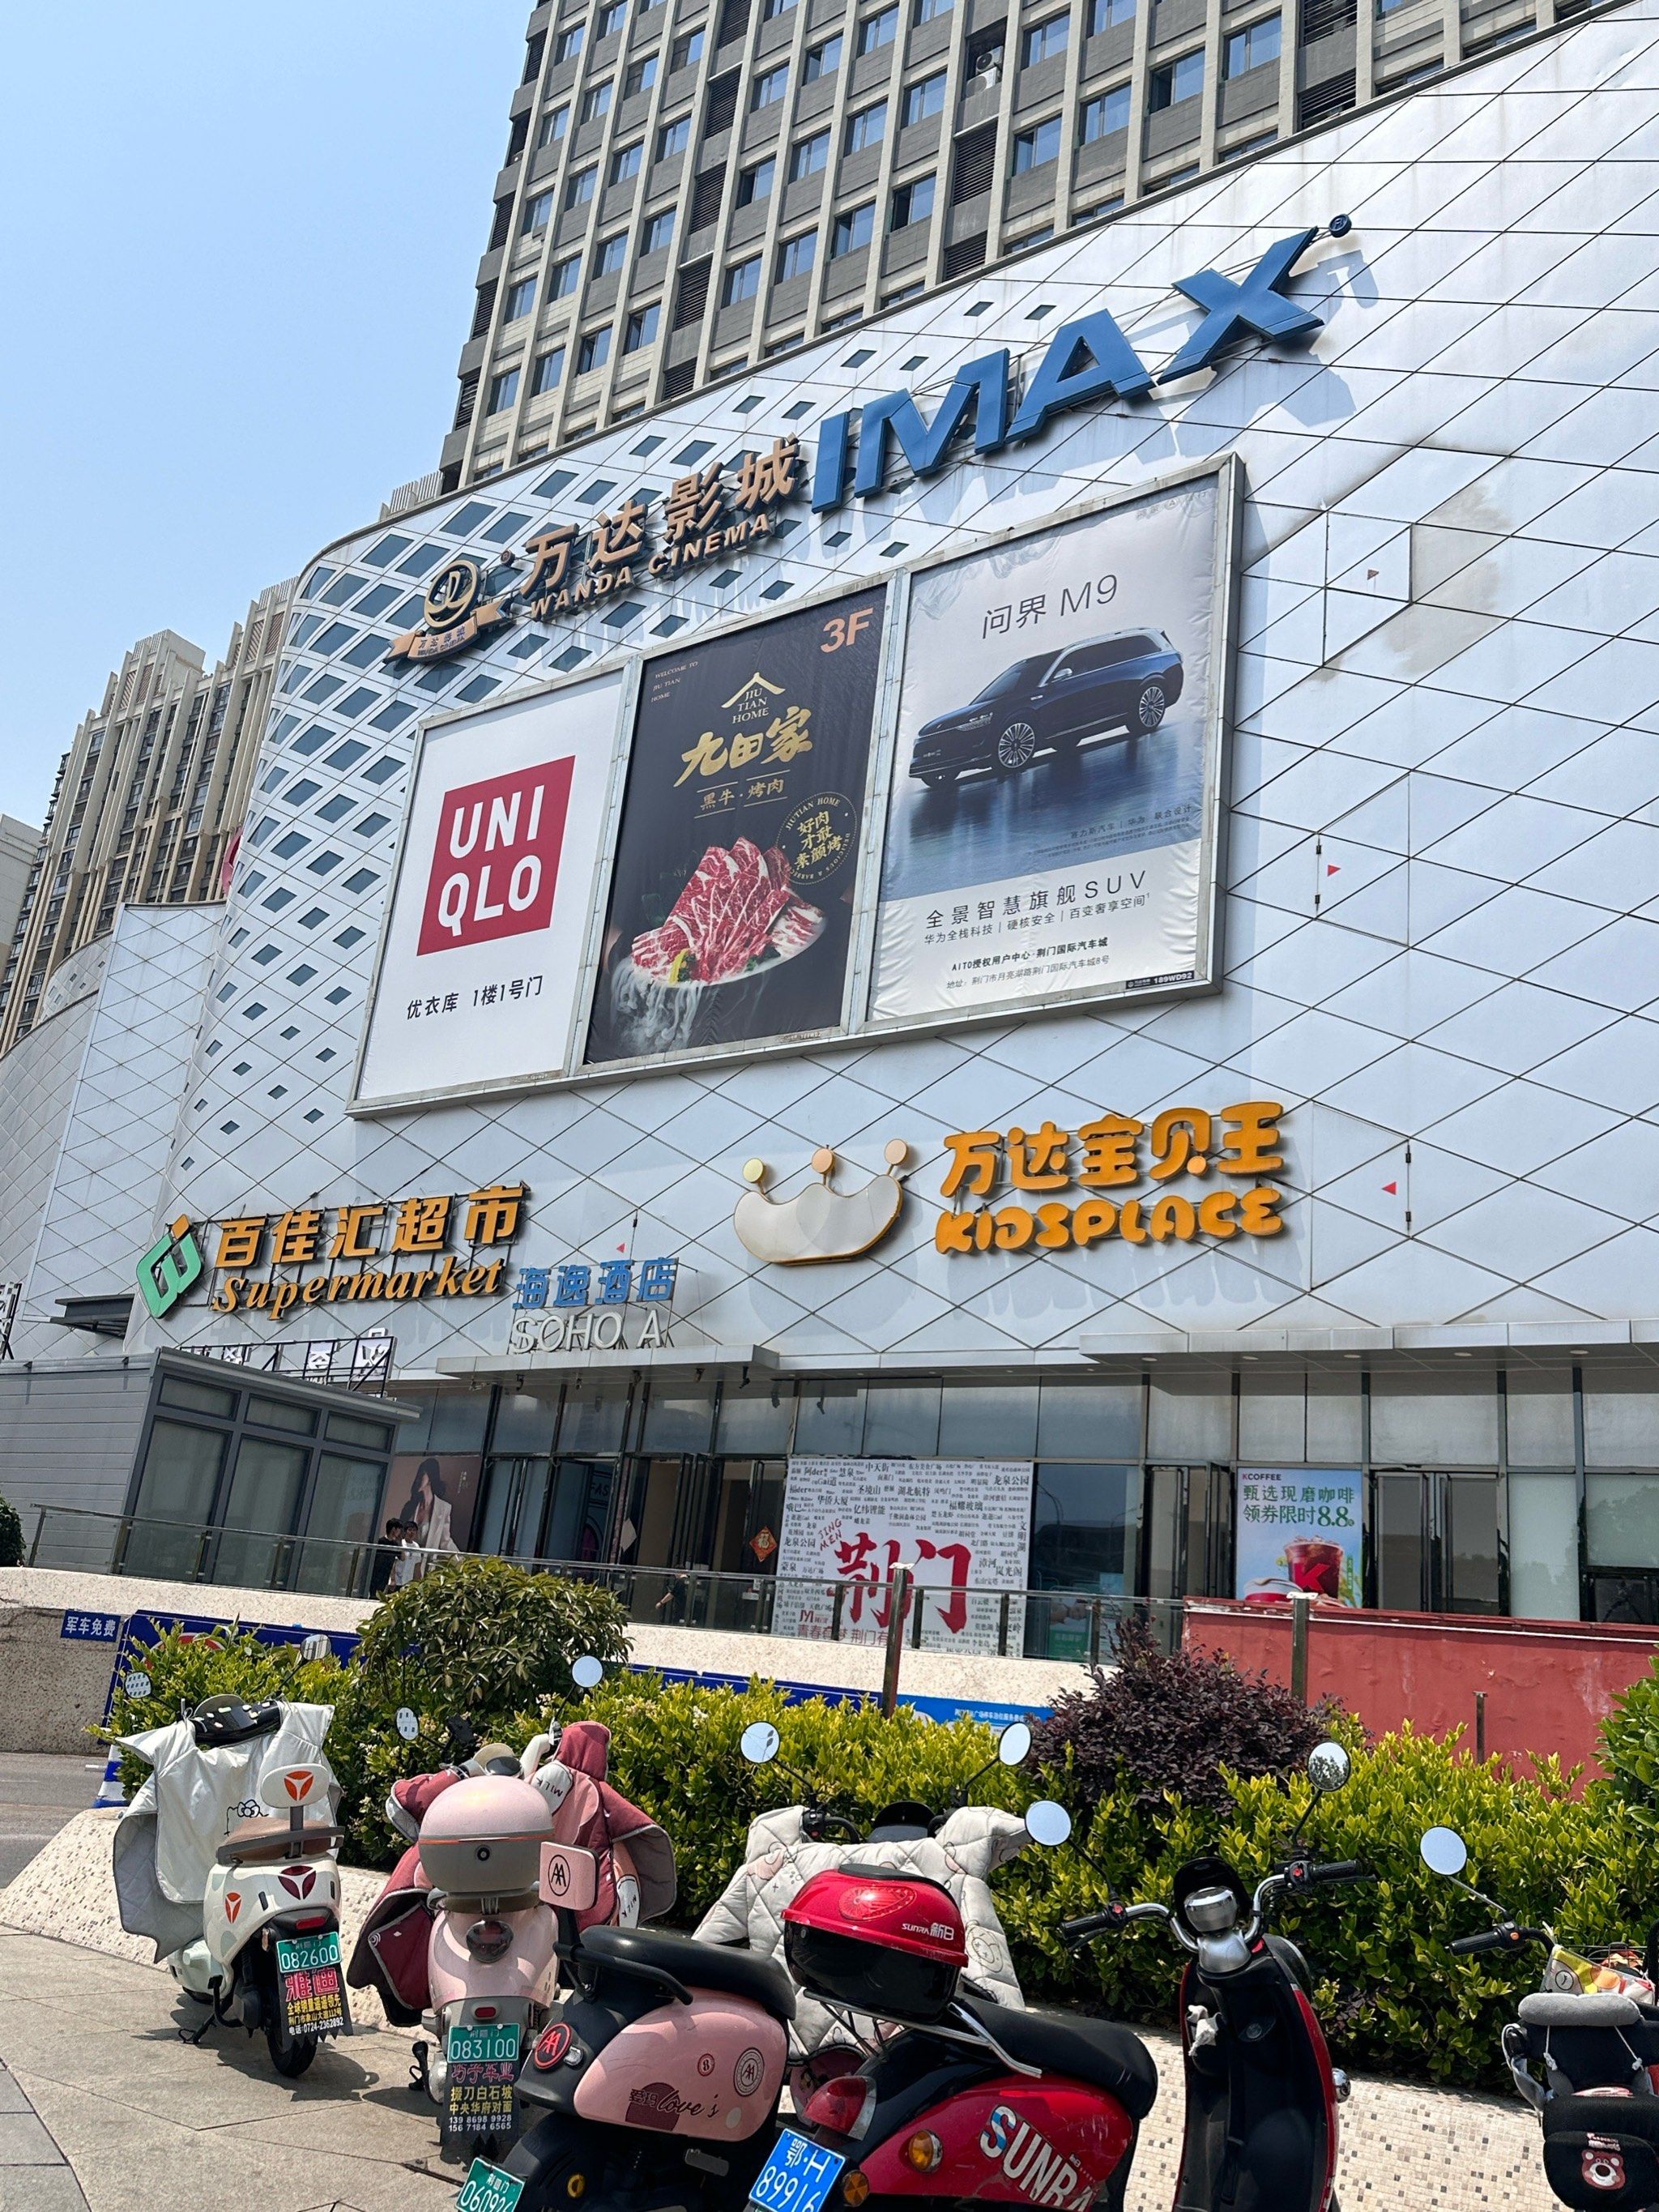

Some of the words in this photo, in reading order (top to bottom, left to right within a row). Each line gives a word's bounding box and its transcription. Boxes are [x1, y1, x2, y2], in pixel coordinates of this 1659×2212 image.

[812, 226, 1325, 515] IMAX
[519, 432, 800, 596] 万达影城
[531, 565, 635, 621] WANDA
[649, 514, 774, 578] CINEMA
[982, 595, 1046, 639] 问界
[1060, 574, 1117, 616] M9
[820, 608, 874, 653] 3F
[655, 665, 686, 679] WELCOME
[664, 678, 681, 687] TIAN
[651, 692, 671, 702] HOME
[738, 698, 769, 712] TIAN
[744, 688, 763, 702] JIU
[732, 707, 770, 724] HOME
[673, 707, 812, 788] 九田家
[450, 785, 544, 859] UNI
[797, 811, 830, 836] 好肉
[801, 826, 834, 851] 才敢
[438, 855, 542, 937] QLO
[926, 870, 1145, 929] 全景智慧旗舰SUV
[924, 924, 993, 944] 华为全栈科技
[1007, 912, 1056, 931] 硬核安全
[407, 993, 458, 1019] 优衣库
[473, 976, 543, 1006] 1楼1号门
[940, 1101, 1285, 1198] 万达宝贝王
[214, 1183, 528, 1268] 百佳汇超市
[935, 1188, 1284, 1254] KIDSPLACE
[212, 1257, 504, 1320] Supermarket
[514, 1257, 677, 1309] 海逸酒店
[512, 1311, 623, 1355] SOHO
[638, 1309, 664, 1349] A
[1242, 1473, 1282, 1481] KCOFFEE
[1243, 1484, 1354, 1504] 甄选现磨咖啡
[65, 1616, 116, 1638] 军车免费
[536, 1778, 564, 1797] MILK
[281, 1945, 338, 1969] 082600
[284, 1967, 340, 2002] 雅迪
[451, 2039, 516, 2060] 083100
[450, 2101, 512, 2115] 中央华府对面
[451, 2084, 513, 2101] 掇刀白石坡
[449, 2124, 463, 2132] 156
[467, 2123, 486, 2131] 7184
[490, 2122, 511, 2130] 6565
[756, 2166, 821, 2212] 89916
